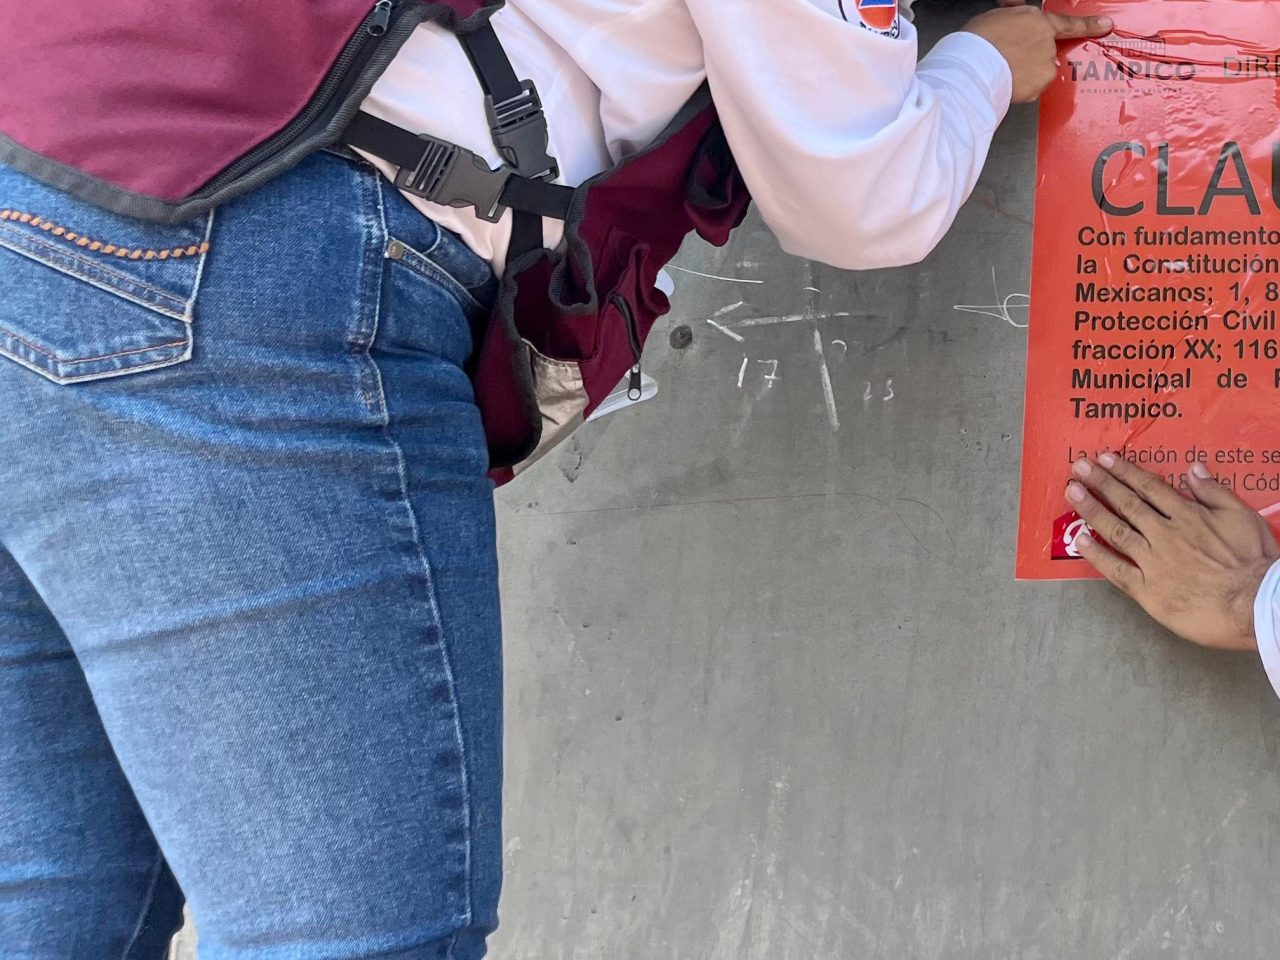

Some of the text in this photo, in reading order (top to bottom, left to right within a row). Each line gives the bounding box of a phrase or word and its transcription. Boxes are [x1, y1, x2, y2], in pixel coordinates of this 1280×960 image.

[1068, 61, 1196, 82] TAMPICO
[1078, 226, 1126, 247] Con
[1077, 255, 1098, 275] la
[1123, 254, 1279, 275] Constitución
[1075, 282, 1213, 306] Mexicanos;
[1229, 283, 1250, 306] 1,
[1074, 310, 1208, 331] Protección
[1222, 310, 1276, 331] Civil
[1072, 339, 1175, 360] fracción
[1184, 340, 1222, 363] XX;
[1071, 368, 1191, 394] Municipal
[1217, 368, 1249, 389] de
[1070, 397, 1183, 424] Tampico.
[1068, 446, 1087, 464] La
[1185, 445, 1208, 464] de
[1215, 448, 1255, 464] este
